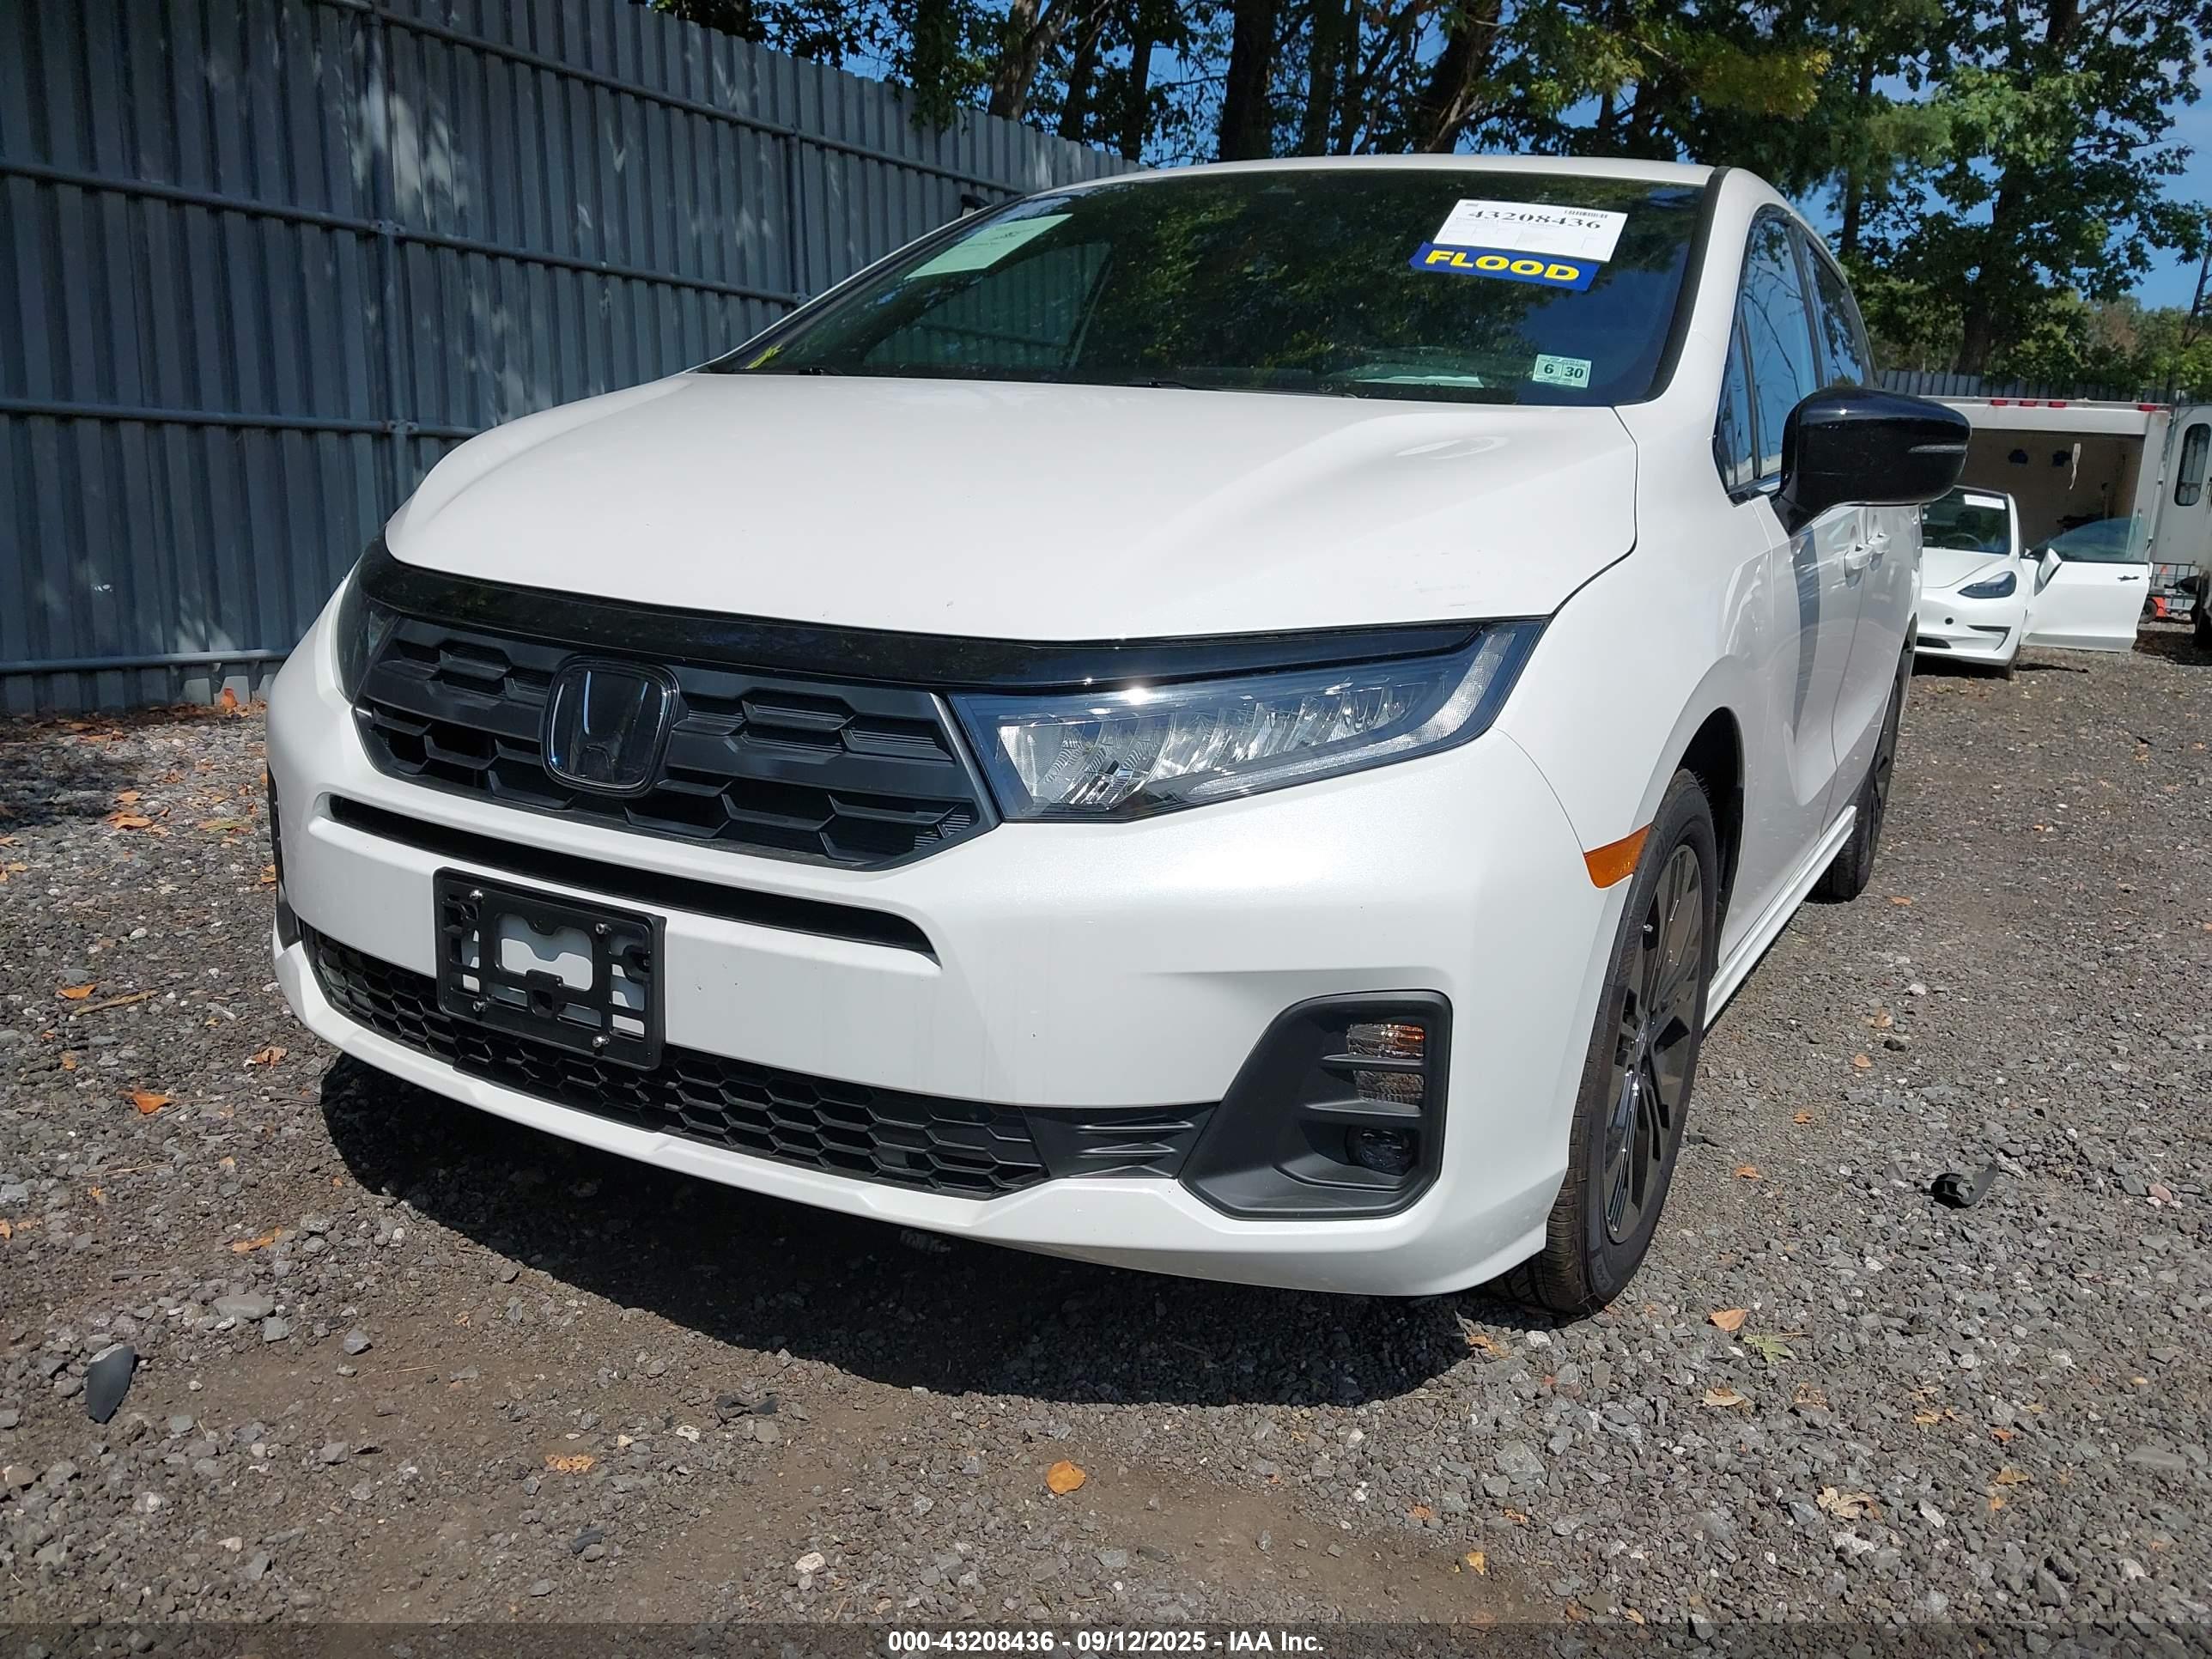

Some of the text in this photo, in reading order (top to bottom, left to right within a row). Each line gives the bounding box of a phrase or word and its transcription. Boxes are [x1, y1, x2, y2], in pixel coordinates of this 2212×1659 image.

[1468, 210, 1601, 230] 43208436
[1425, 250, 1580, 280] FLOOD
[1544, 363, 1583, 379] 6 30
